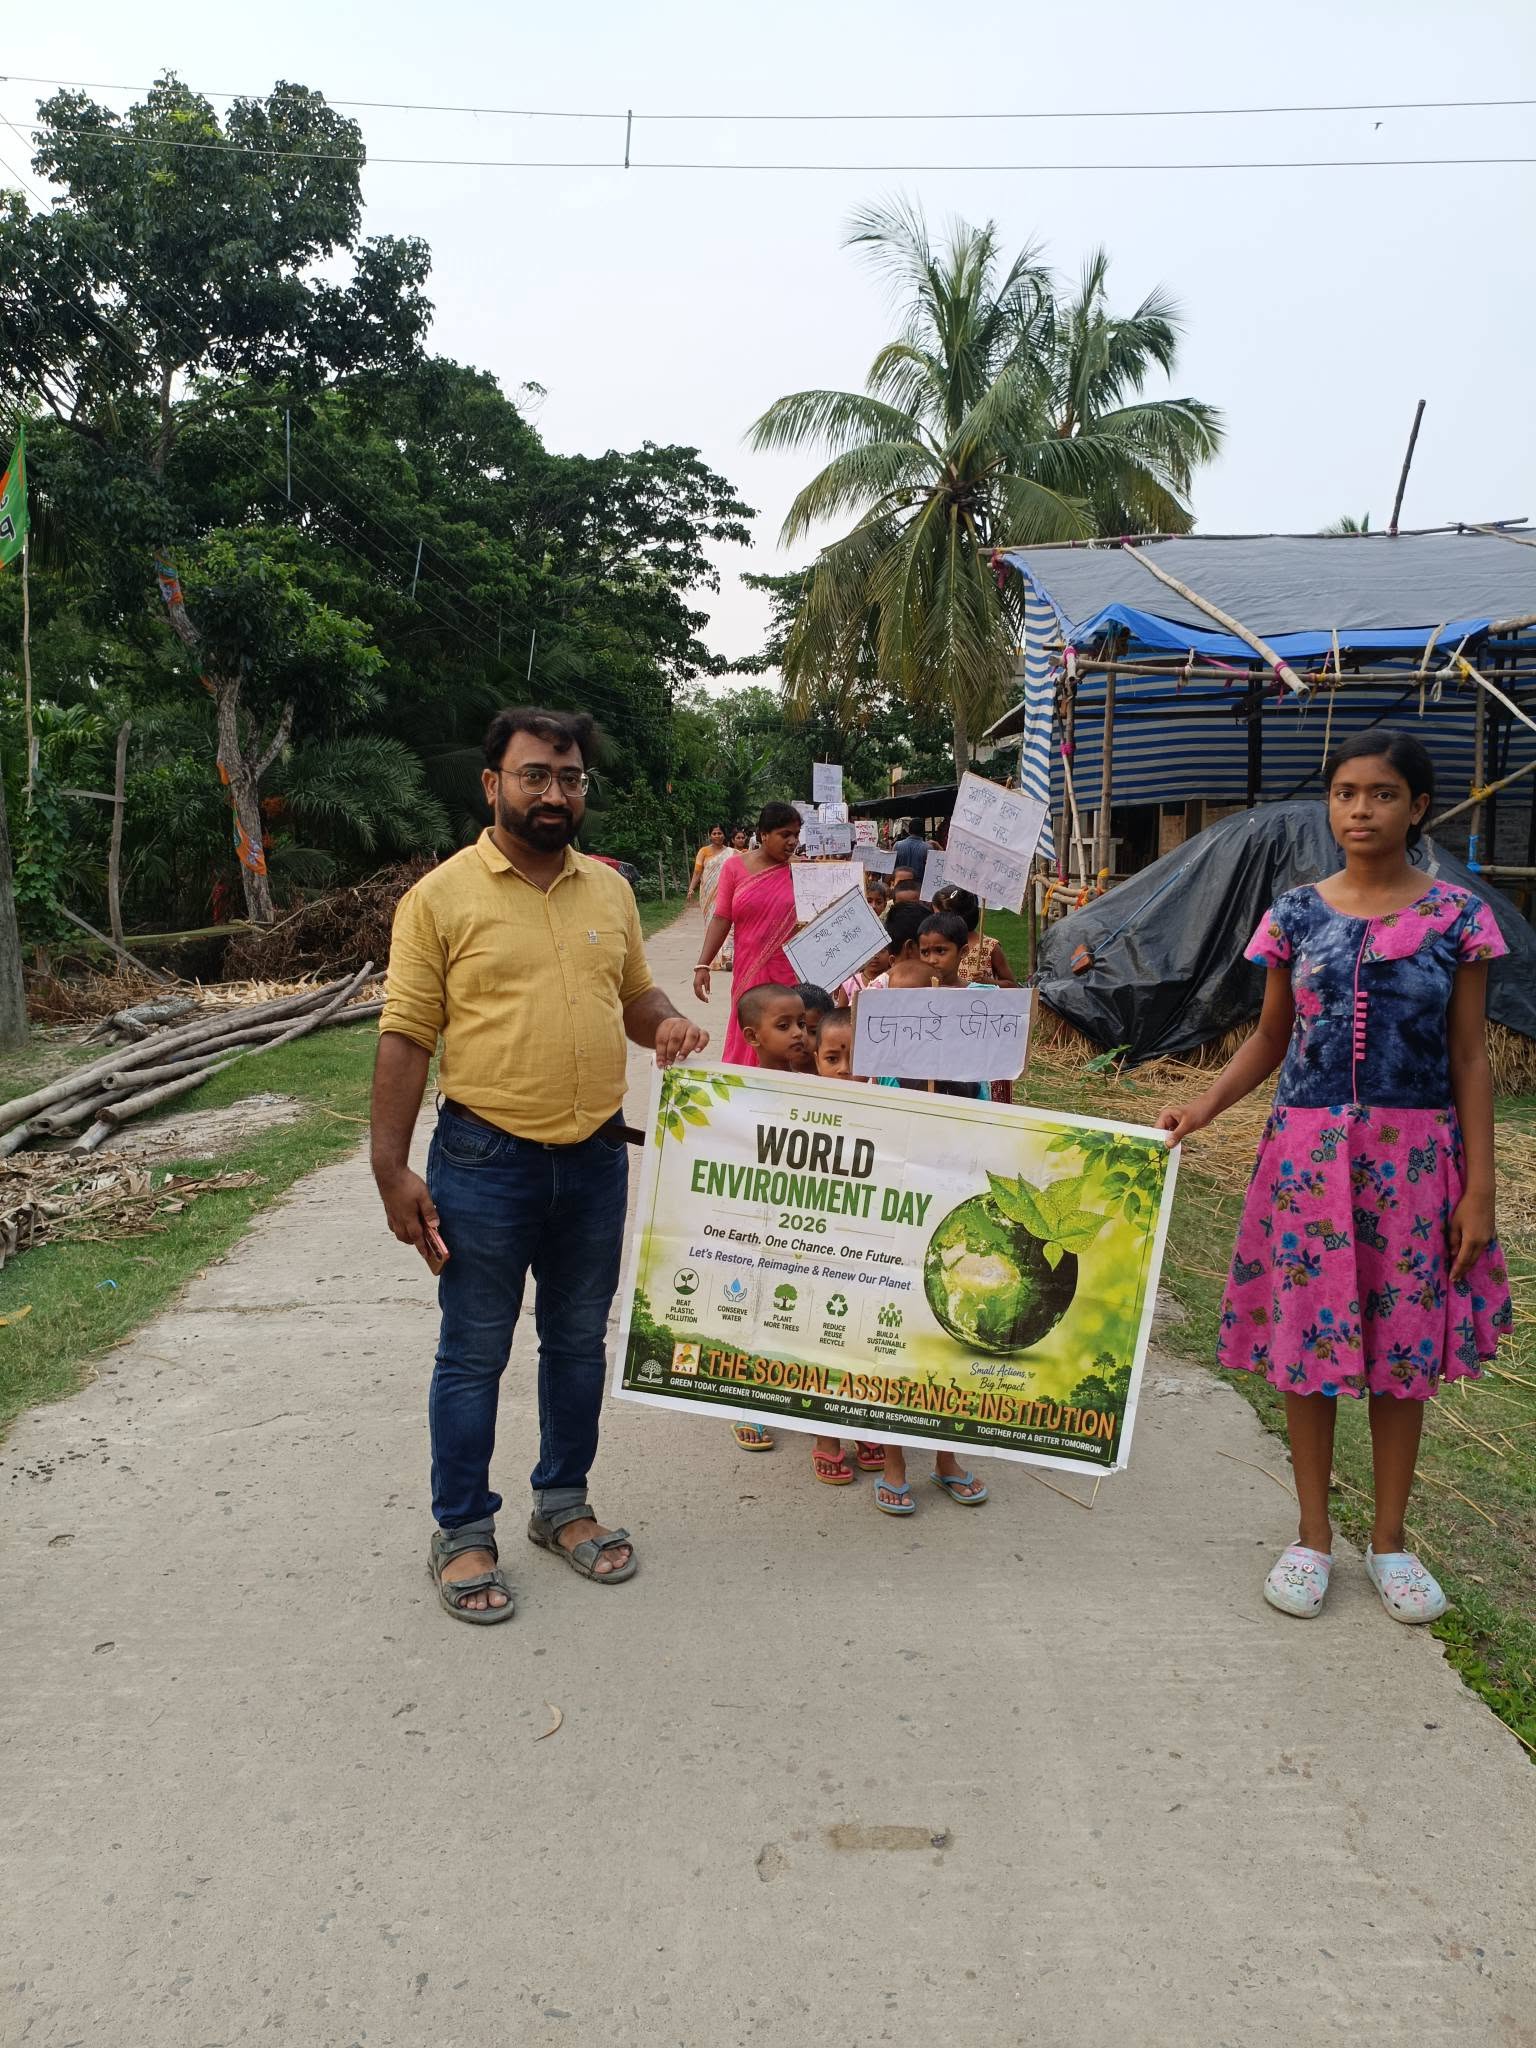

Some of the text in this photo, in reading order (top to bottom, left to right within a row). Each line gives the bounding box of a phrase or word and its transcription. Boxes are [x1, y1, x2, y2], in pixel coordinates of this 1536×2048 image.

[868, 1000, 1021, 1046] জলই জীবন
[789, 1108, 843, 1127] 5 JUNE
[756, 1124, 875, 1179] WORLD
[690, 1159, 933, 1227] ENVIRONMENT DAY
[778, 1212, 827, 1234] 2026
[703, 1224, 904, 1266] One Earth. One Chance. One Future.
[689, 1246, 911, 1291] Let's Restore, Reimagine & Renew Our Planet
[675, 1299, 692, 1307] BEAT
[670, 1306, 695, 1315] PLASTIC
[717, 1305, 748, 1316] CONSERVE
[665, 1313, 698, 1324] POLLUTION
[722, 1313, 742, 1323] WATER
[772, 1314, 793, 1323] PLANT
[763, 1320, 800, 1333] MORE TREES
[822, 1322, 846, 1332] REDUCE
[823, 1330, 843, 1339] REUSE
[876, 1330, 894, 1339] BUILD
[819, 1337, 846, 1347] RECYCLE
[866, 1337, 907, 1349] SUSTAINABLE
[874, 1346, 897, 1356] FUTURE
[969, 1362, 995, 1377] Small
[670, 1377, 792, 1404] GREEN TODAY, GREENER TOMORROW
[979, 1377, 997, 1392] Big
[708, 1350, 1118, 1440] THE SOCIAL ASSISTANCE INSTITUTION
[824, 1402, 941, 1428] OUR PLANET, OUR RESPONSIBILITY
[976, 1425, 1102, 1454] TOGETHER FOR A BETTER TOMORROW
